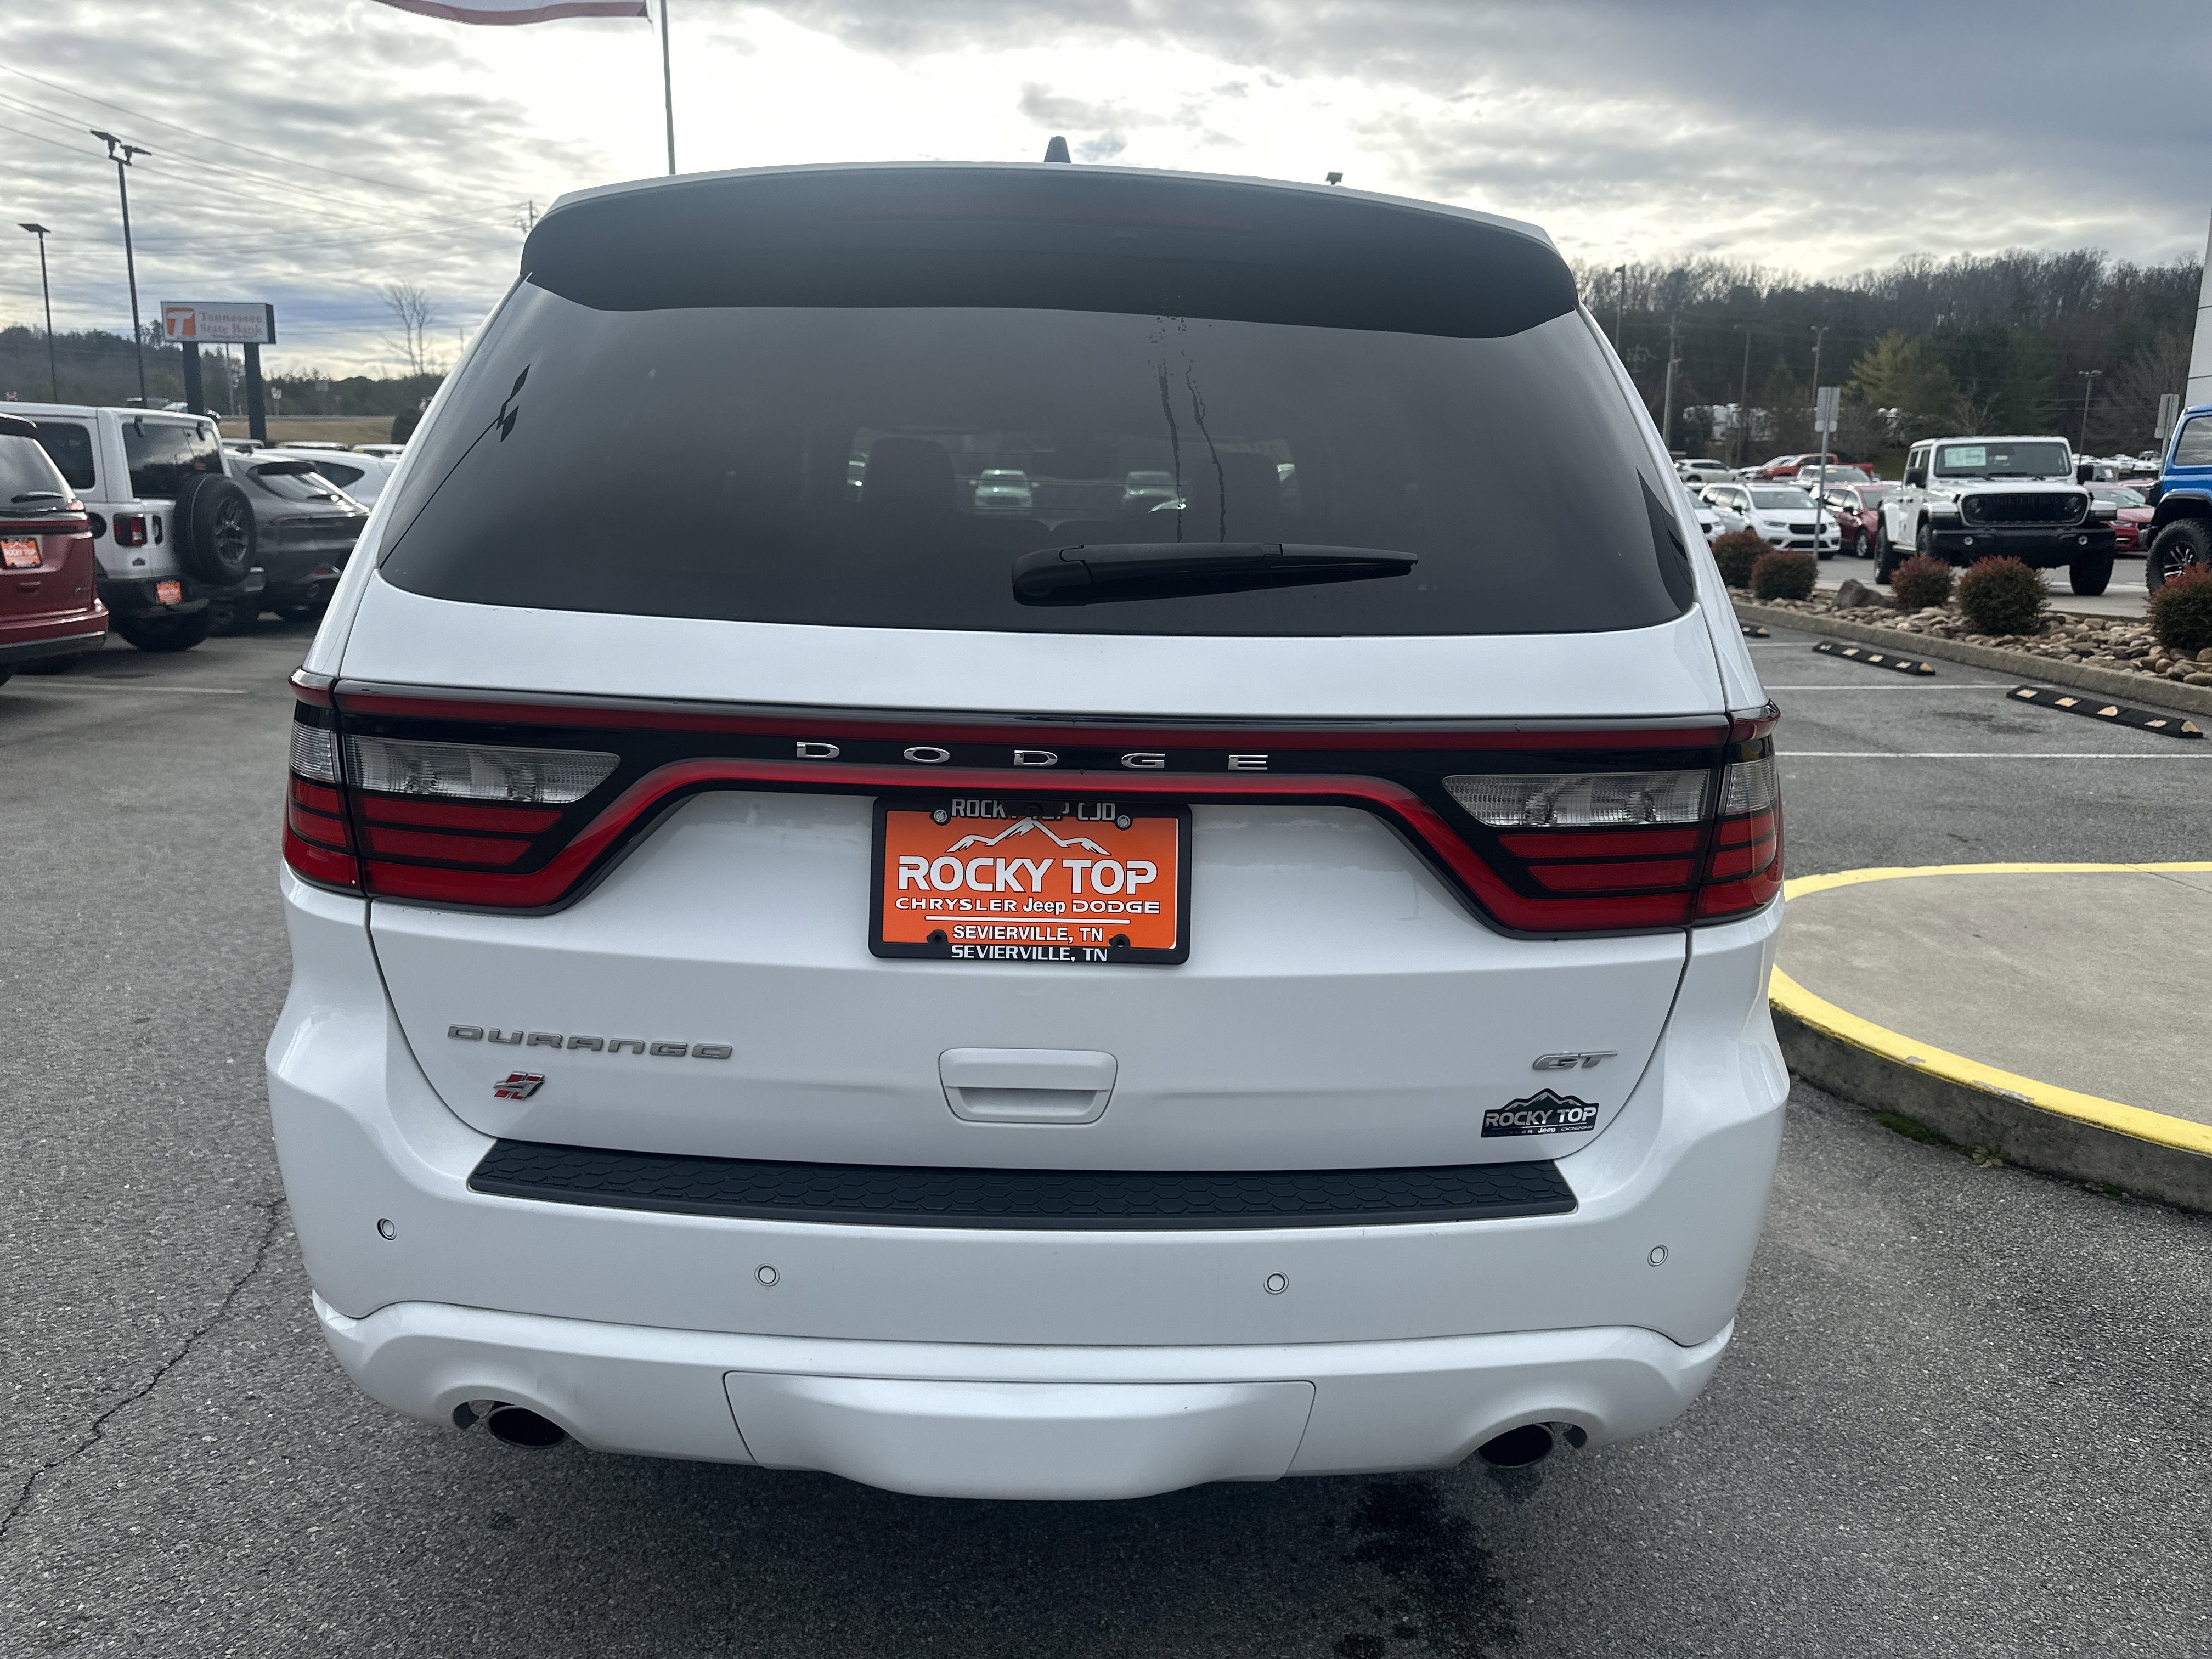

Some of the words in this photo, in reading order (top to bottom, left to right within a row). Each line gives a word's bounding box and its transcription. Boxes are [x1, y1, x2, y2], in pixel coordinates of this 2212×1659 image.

[199, 312, 262, 322] Tennessee
[200, 323, 229, 333] State
[232, 323, 262, 334] Bank
[797, 742, 1268, 770] DODGE
[951, 798, 1017, 819] ROCK
[1077, 802, 1116, 821] CJD
[898, 855, 1056, 893] ROCKY
[1062, 858, 1159, 895] TOP
[895, 897, 1017, 912] CHRYSLER
[1023, 898, 1066, 915] Jeep
[1072, 900, 1161, 914] DODGE
[953, 925, 1074, 943] SEVIERVILLE,
[1079, 928, 1104, 942] TN
[951, 945, 1076, 962] SEVIERVILLE,
[1084, 947, 1108, 961] TN
[448, 1024, 733, 1059] DURANGO
[1532, 1051, 1618, 1070] GT
[1486, 1111, 1553, 1127] ROCKY
[1557, 1107, 1597, 1123] TOP
